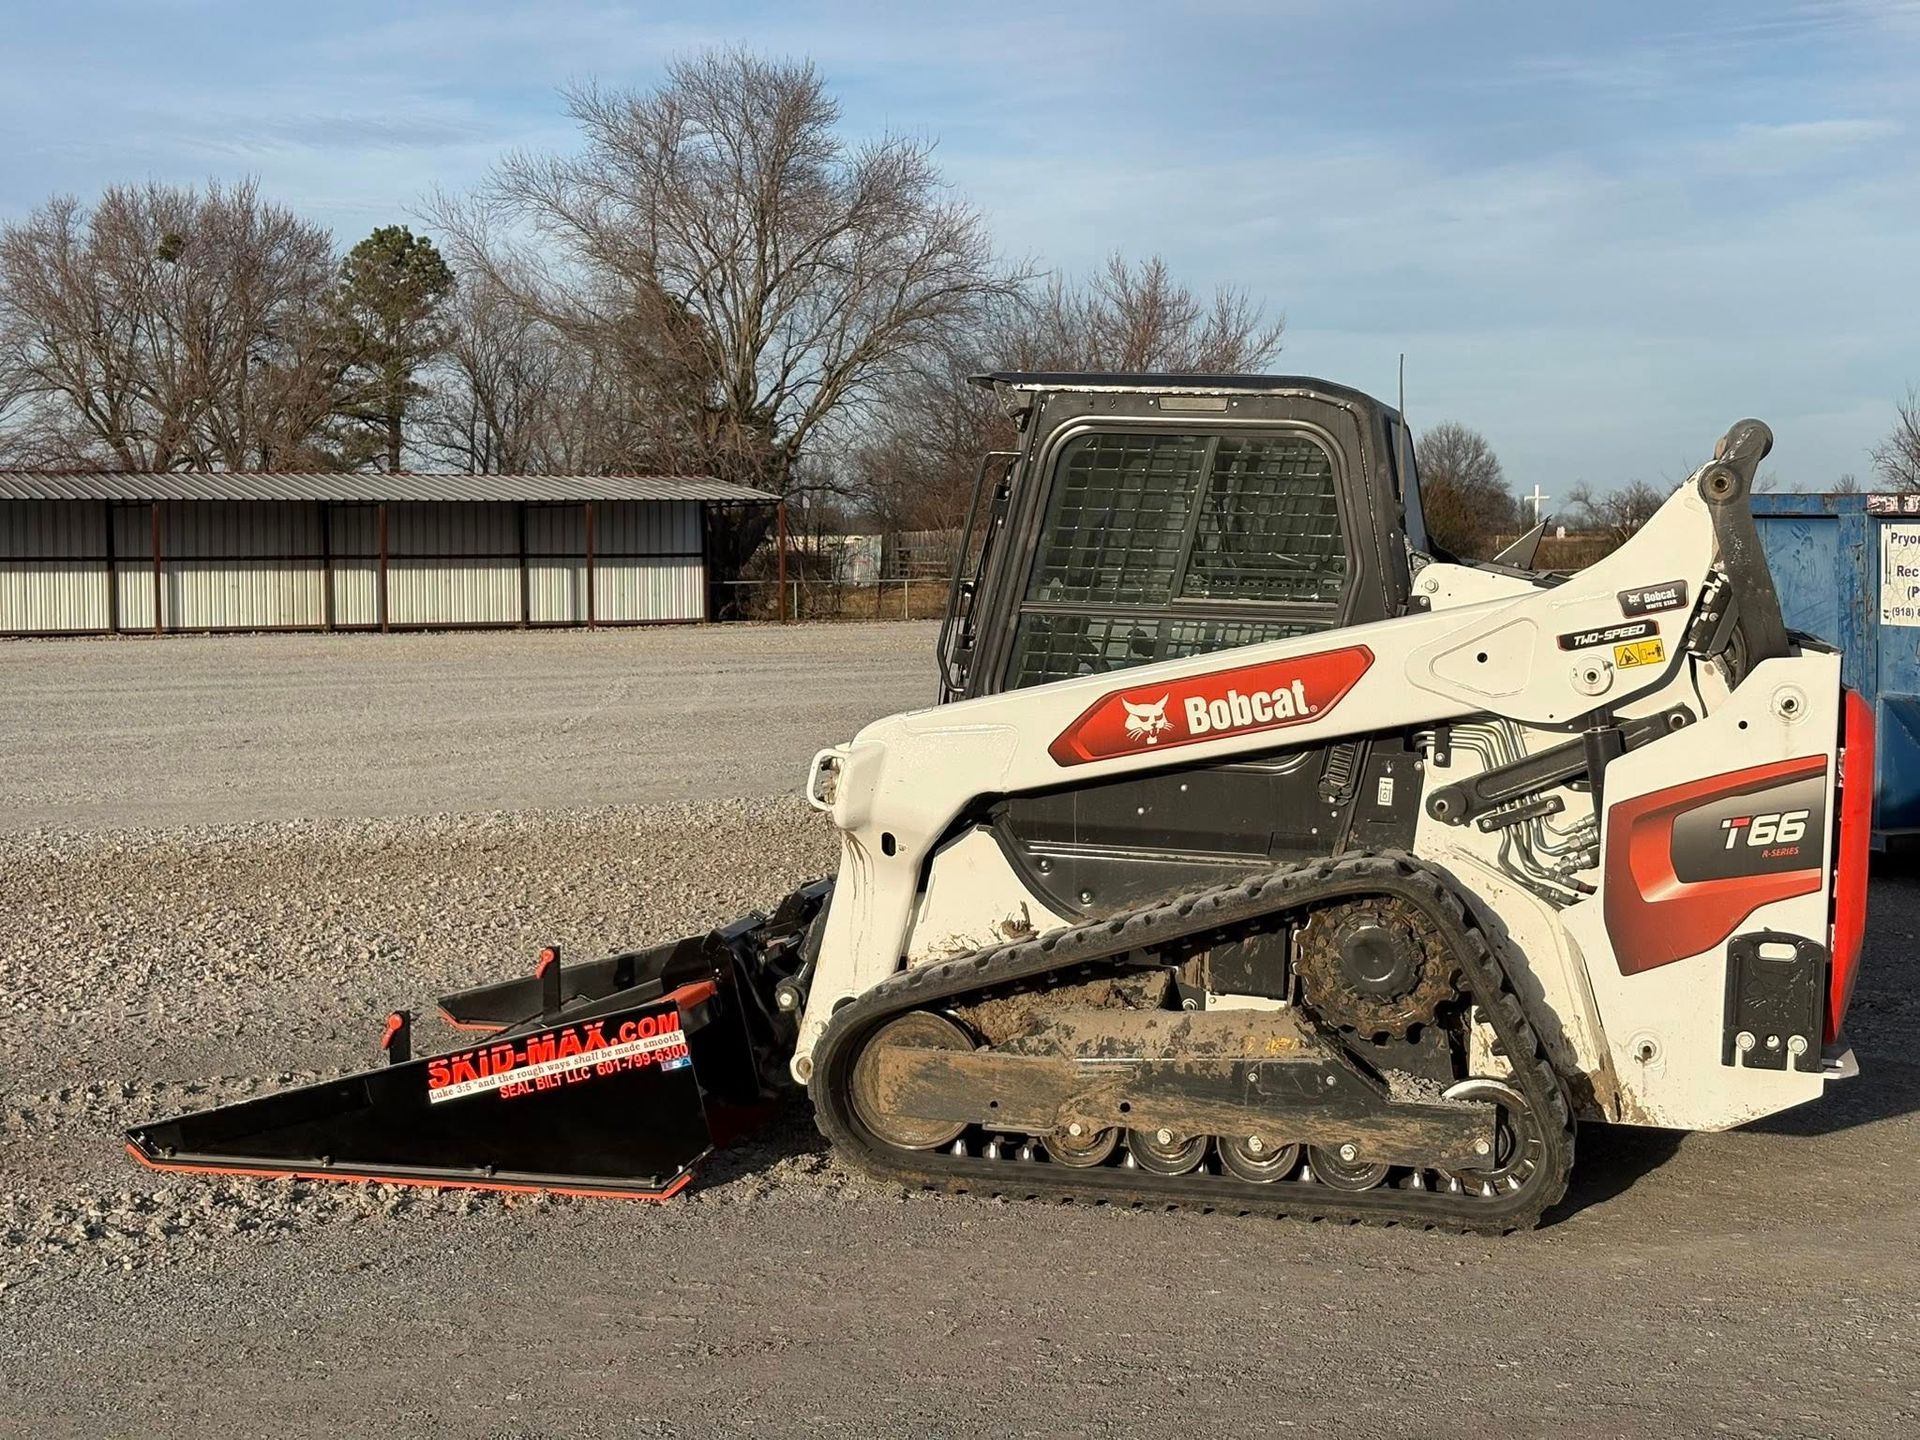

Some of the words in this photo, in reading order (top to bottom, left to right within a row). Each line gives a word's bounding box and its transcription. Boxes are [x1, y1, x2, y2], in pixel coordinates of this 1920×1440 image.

[1897, 565, 1919, 577] Rec
[1644, 588, 1676, 603] Bobcat
[1892, 607, 1914, 619] (918)
[1574, 624, 1646, 646] TWO-SPEED
[1184, 679, 1309, 734] Bobcat
[1722, 810, 1809, 849] T66
[1762, 846, 1800, 858] R-SERIES
[428, 1011, 679, 1089] SKID-MAX.COM
[430, 1089, 453, 1100] Luke
[456, 1083, 472, 1093] 3:5
[498, 1073, 515, 1083] the
[517, 1066, 544, 1079] rough
[547, 1060, 571, 1072] ways
[574, 1051, 599, 1065] shall
[601, 1049, 612, 1057] be
[615, 1042, 641, 1055] made
[500, 1082, 534, 1098] SEAL
[566, 1067, 591, 1083] LLC
[596, 1043, 689, 1076] 601-799-6300
